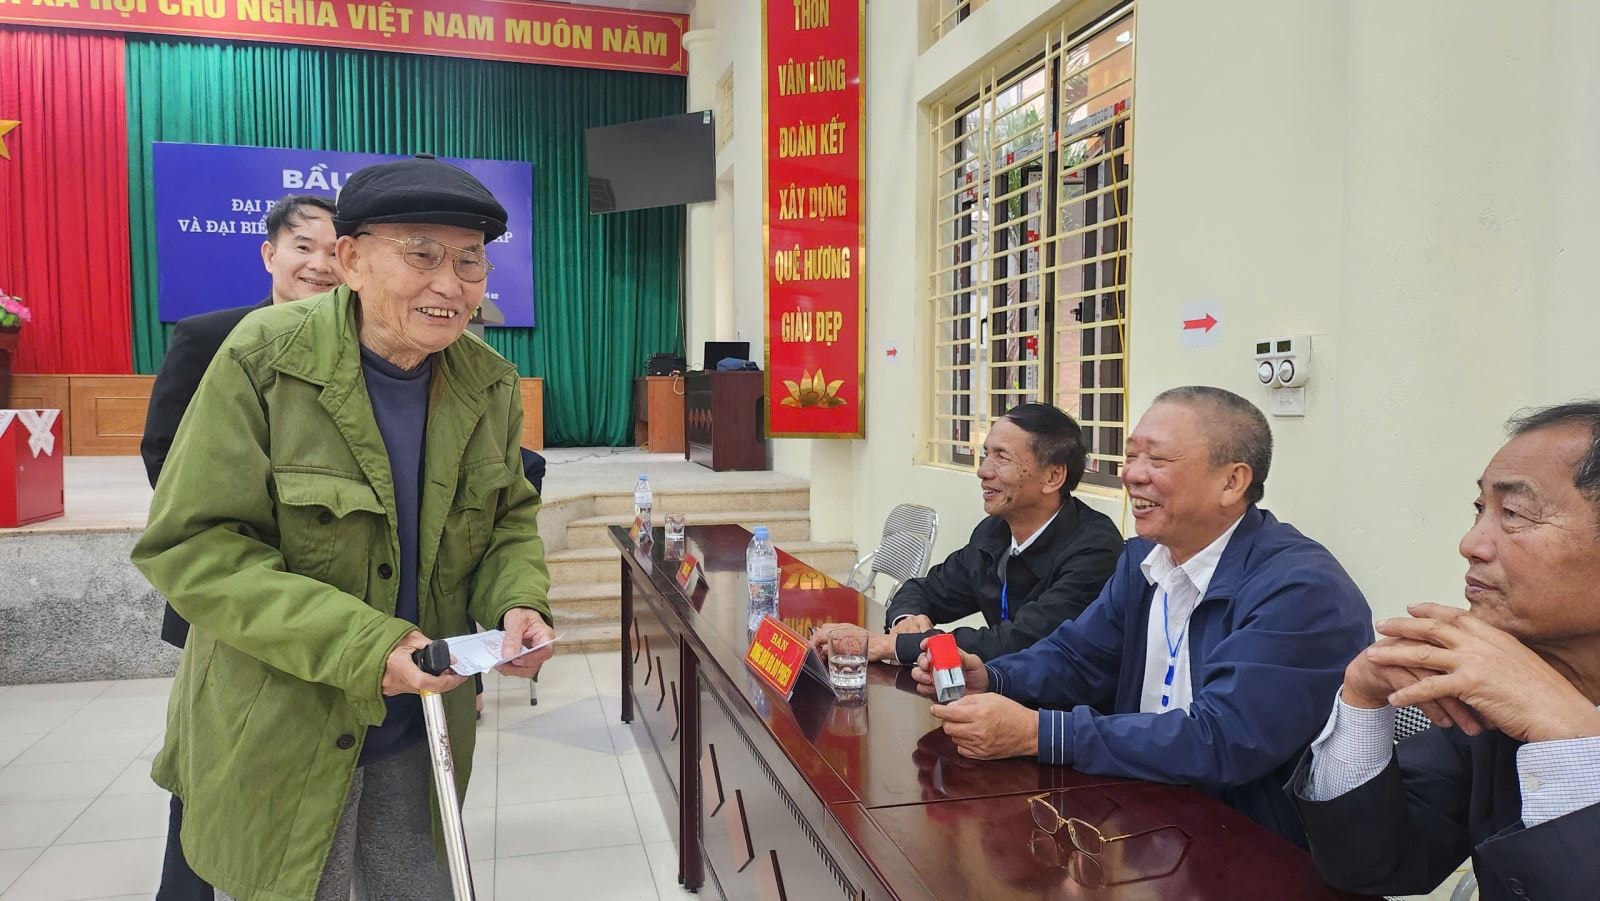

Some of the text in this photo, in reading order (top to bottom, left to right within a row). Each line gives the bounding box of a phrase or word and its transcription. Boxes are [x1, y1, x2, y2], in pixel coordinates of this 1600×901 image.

[347, 1, 413, 37] VIỆT
[423, 10, 494, 42] NAM
[504, 18, 592, 50] MUÔN
[602, 24, 667, 57] NĂM
[778, 56, 846, 96] VÂN LŨNG
[779, 113, 846, 159] ĐOÀN KẾT
[231, 199, 261, 215] ĐẠI
[779, 183, 846, 222] XÂY DỰNG
[178, 213, 269, 236] VÀ ĐẠI BIỂ
[775, 244, 851, 285] QUÊ HƯƠNG
[781, 306, 843, 346] GIÀU ĐẸP
